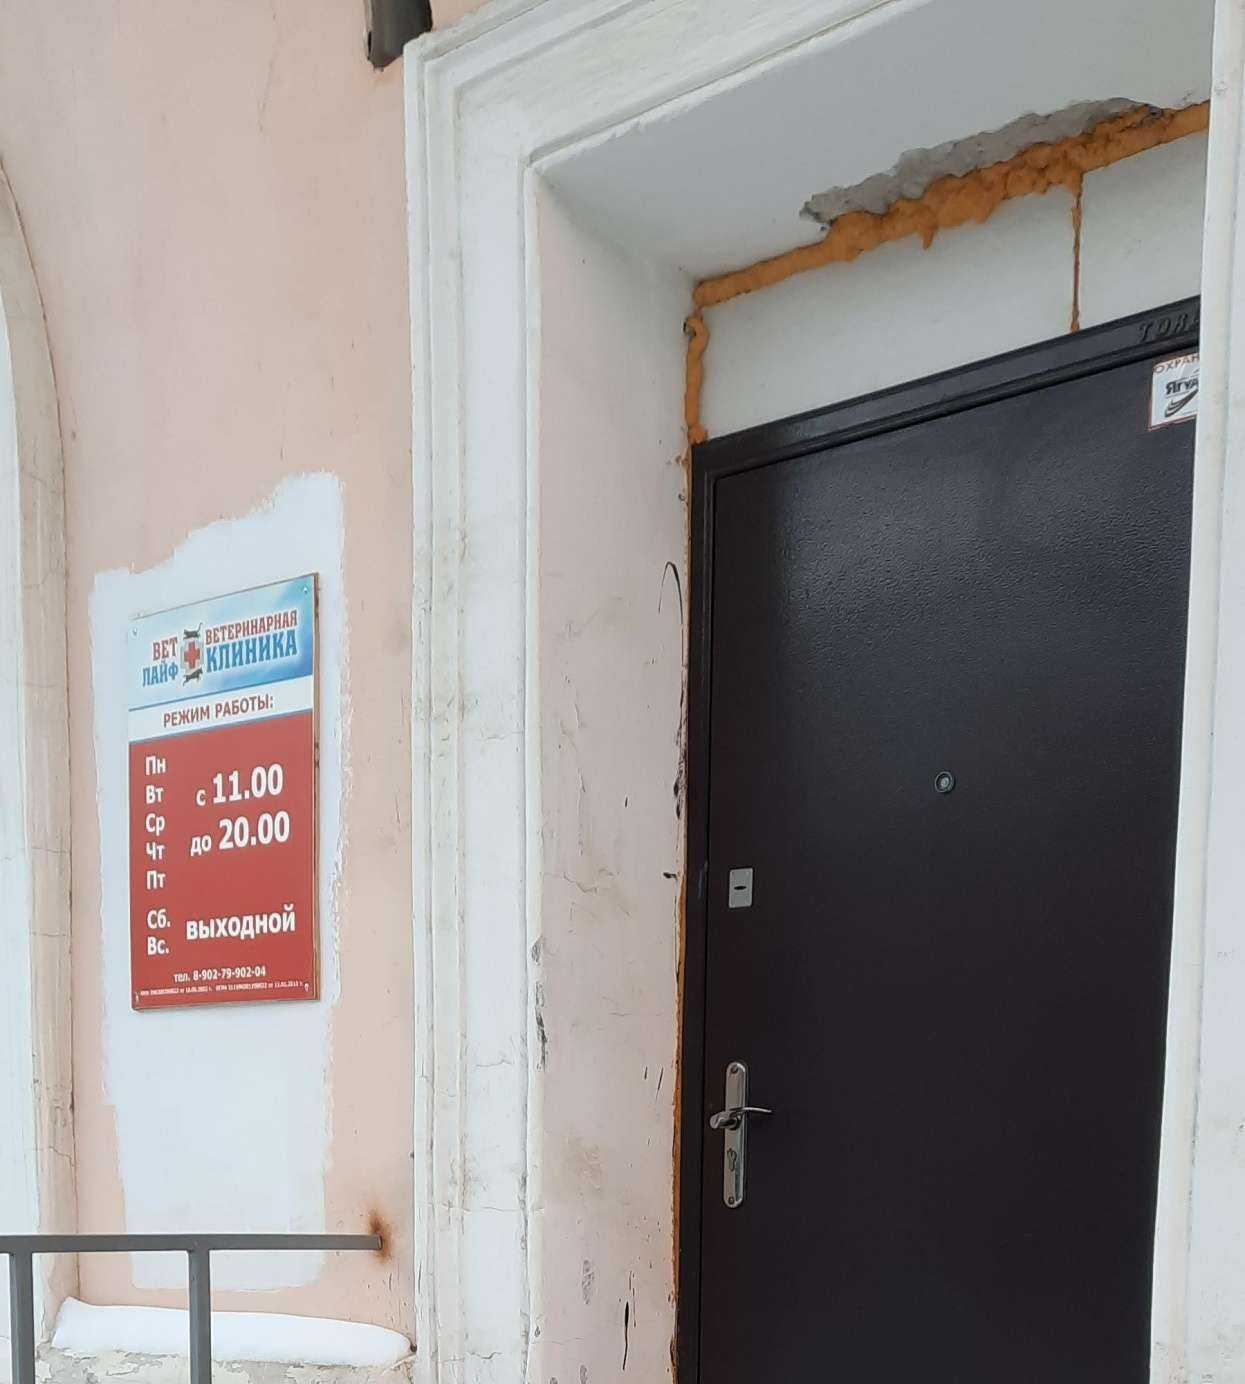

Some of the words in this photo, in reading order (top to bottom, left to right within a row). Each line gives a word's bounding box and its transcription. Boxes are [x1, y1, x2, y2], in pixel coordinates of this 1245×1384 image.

[205, 609, 298, 645] ВЕТЕРИНАРНАЯ
[152, 637, 178, 661] ВЕТ
[206, 629, 298, 673] КЛИНИКА
[142, 661, 179, 687] ЛАЙФ
[163, 706, 210, 728] РЕЖИМ
[215, 694, 274, 718] РАБОТЫ:
[145, 756, 166, 776] Пн
[145, 784, 164, 804] Вт
[213, 764, 283, 804] 11.00
[145, 813, 165, 836] Ср
[190, 835, 212, 856] до
[219, 811, 290, 850] 20.00
[146, 842, 165, 860] Чт
[146, 870, 165, 889] Пт
[147, 909, 171, 929] Сб.
[147, 936, 169, 955] Вс.
[193, 965, 266, 981] 8-902-79-902-04
